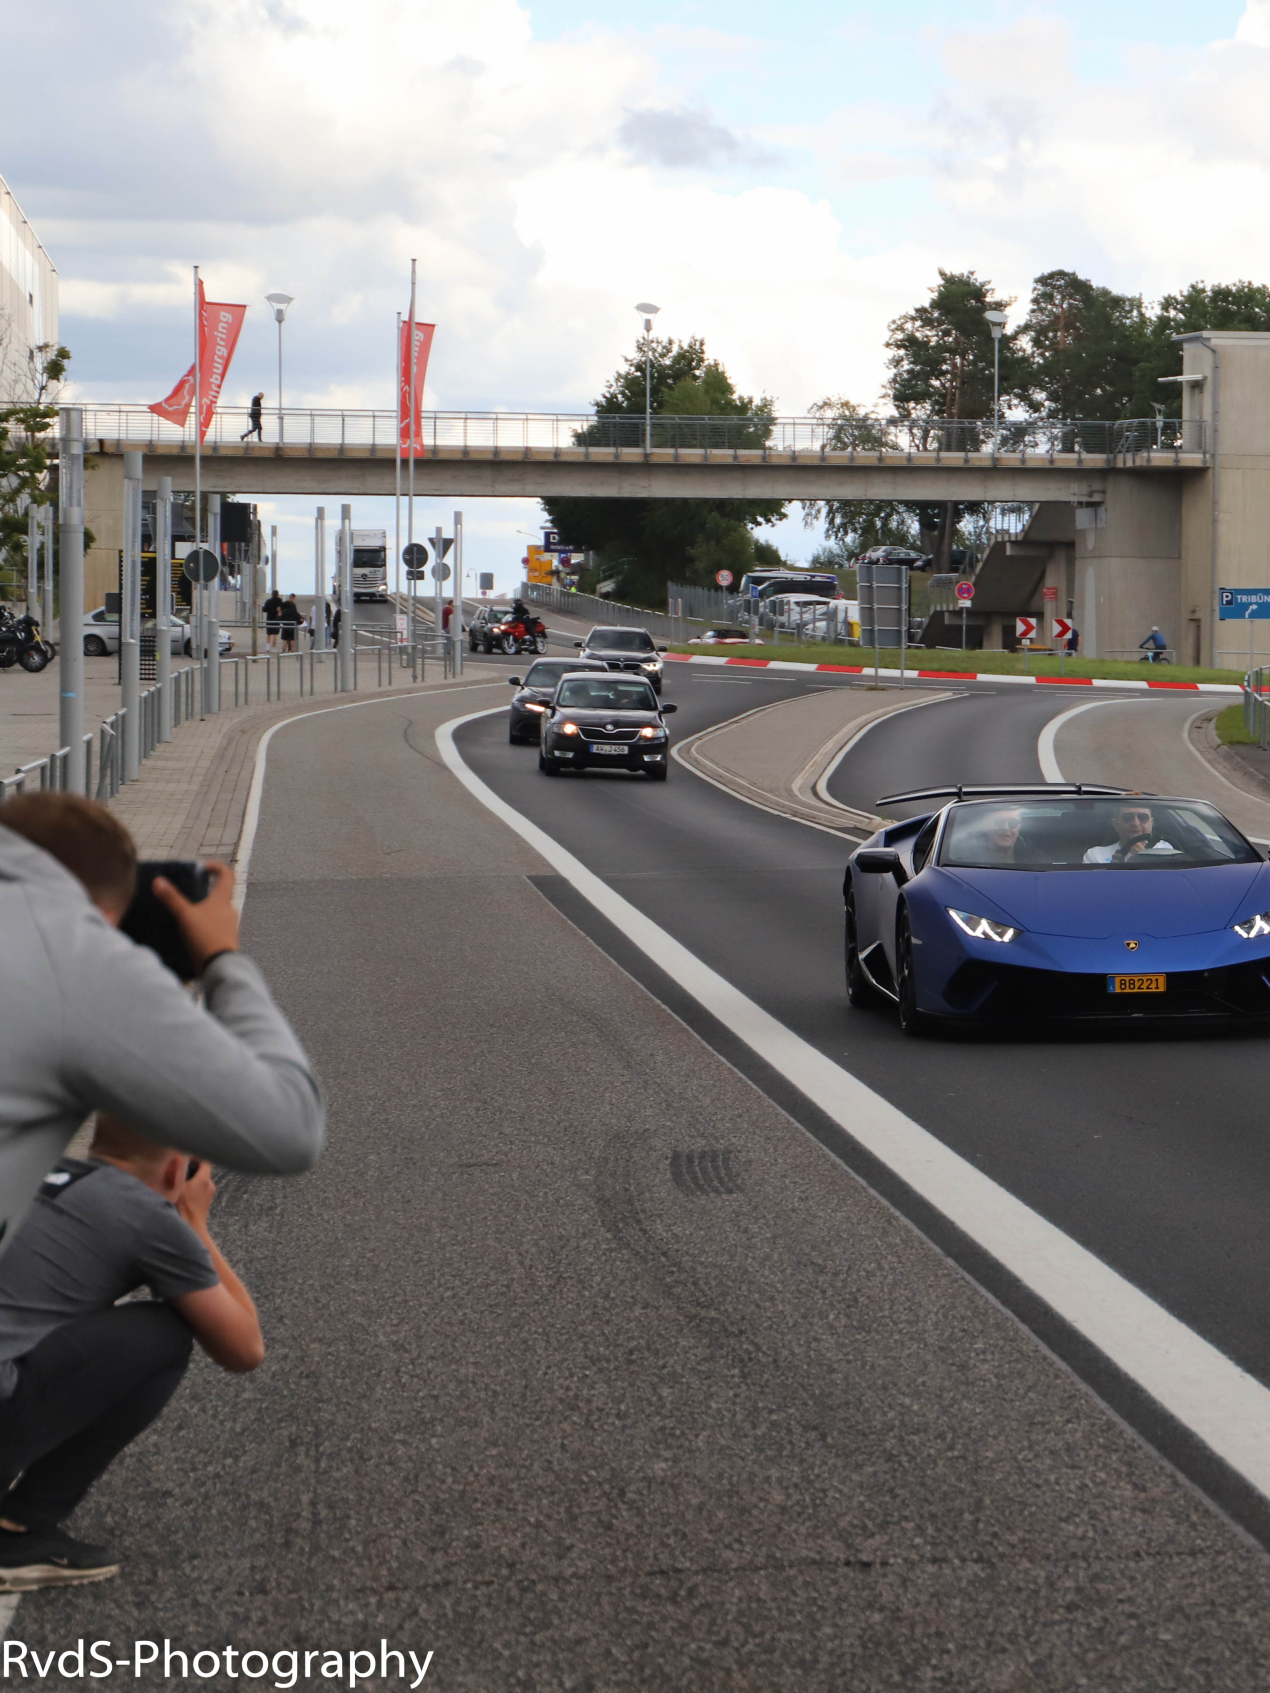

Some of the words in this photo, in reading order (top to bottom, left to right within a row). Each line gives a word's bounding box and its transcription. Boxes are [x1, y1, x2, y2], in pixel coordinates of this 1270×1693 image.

[720, 574, 729, 582] 50
[1223, 593, 1232, 604] P
[1119, 978, 1159, 990] 88221
